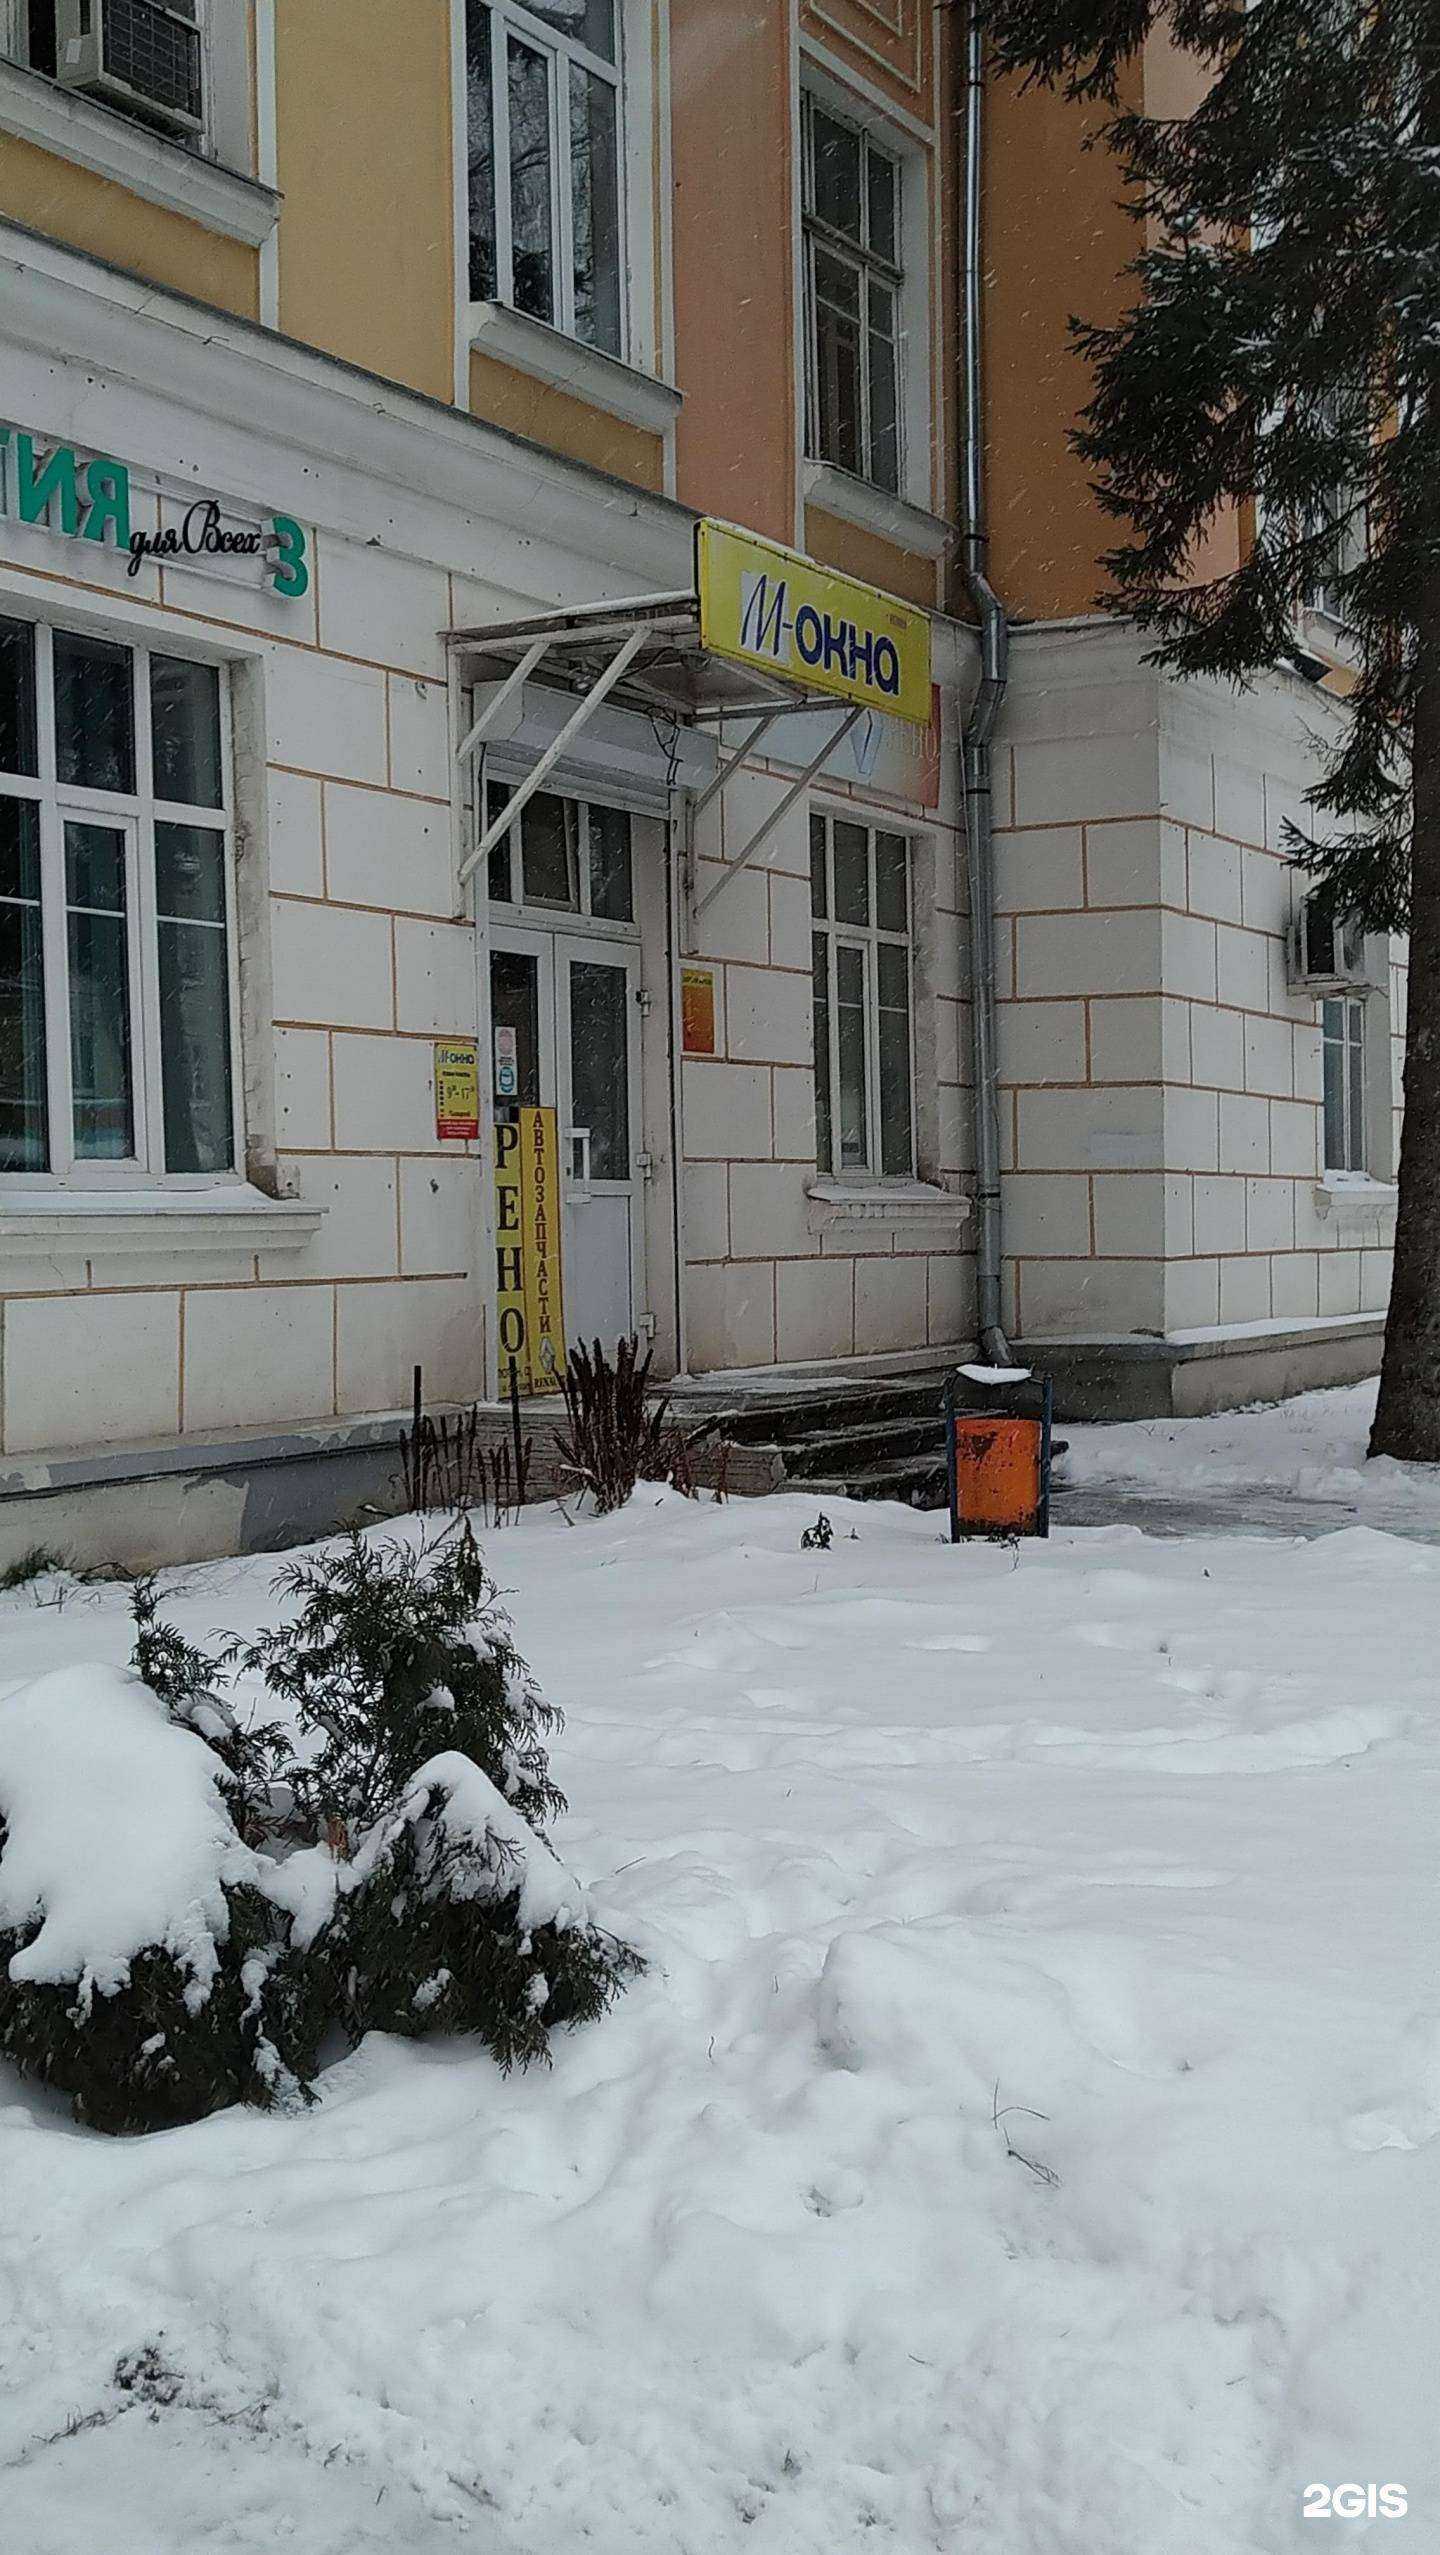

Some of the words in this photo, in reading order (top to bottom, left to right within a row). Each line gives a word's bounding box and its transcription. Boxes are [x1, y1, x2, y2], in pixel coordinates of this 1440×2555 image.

[0, 428, 130, 551] ИЯ
[182, 500, 260, 556] Всех
[494, 1124, 524, 1354] РЕНО
[532, 1110, 552, 1334] АВТОЗАПЧАСТИ
